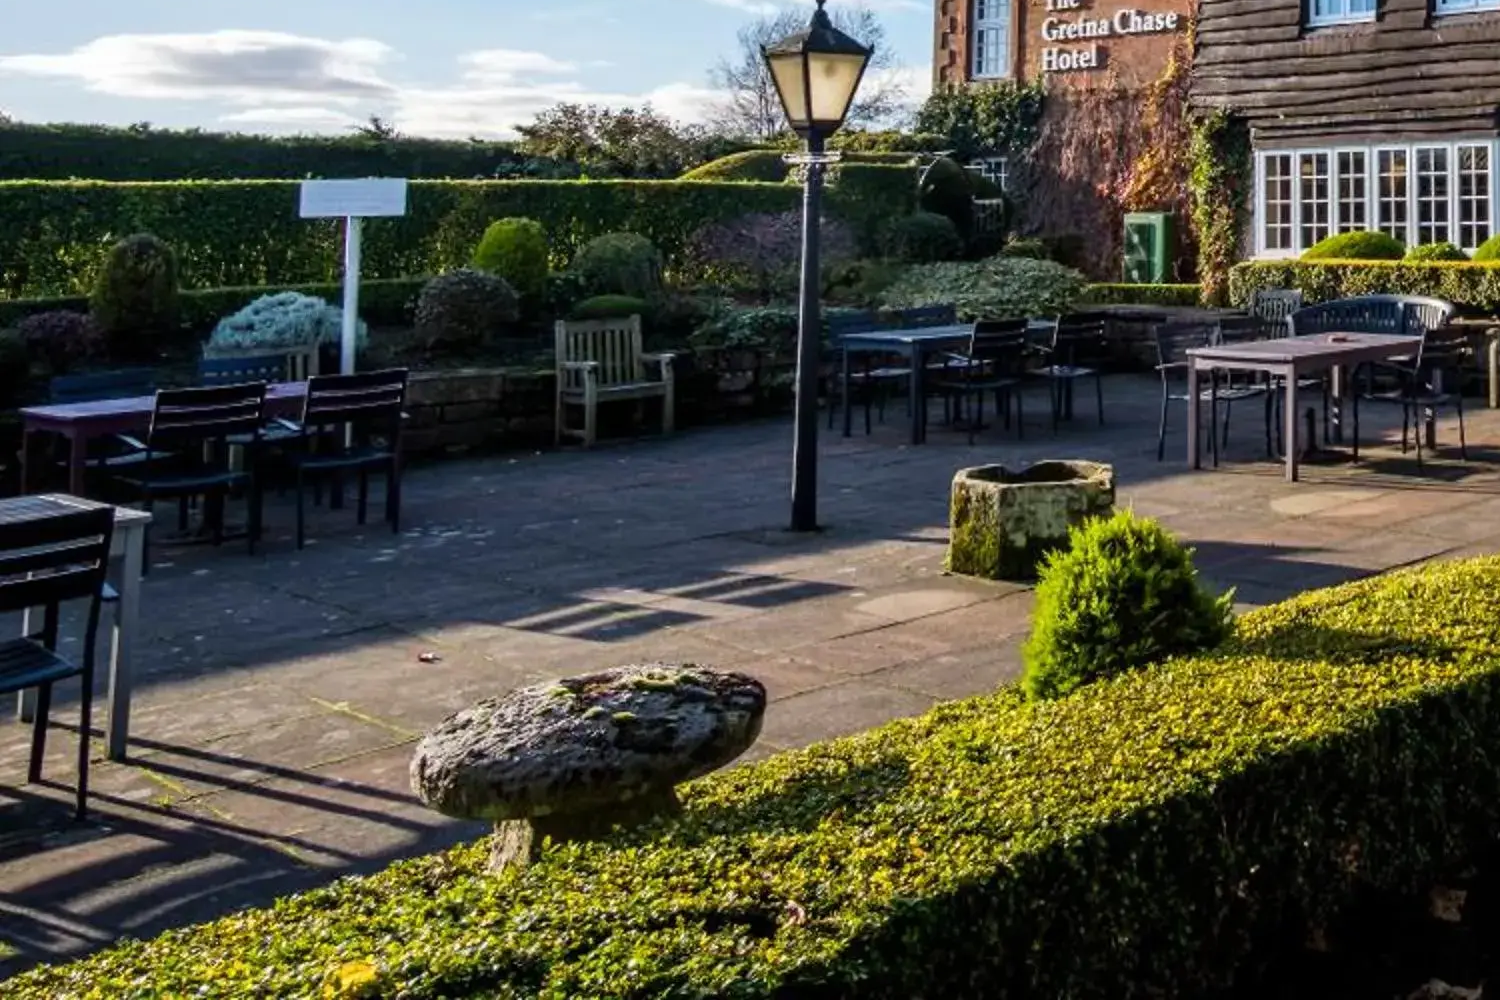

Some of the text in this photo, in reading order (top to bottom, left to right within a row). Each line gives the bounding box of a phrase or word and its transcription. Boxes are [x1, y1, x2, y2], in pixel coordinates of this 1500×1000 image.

[1041, 9, 1178, 41] Gretna Chase
[1041, 44, 1098, 71] Hotel
